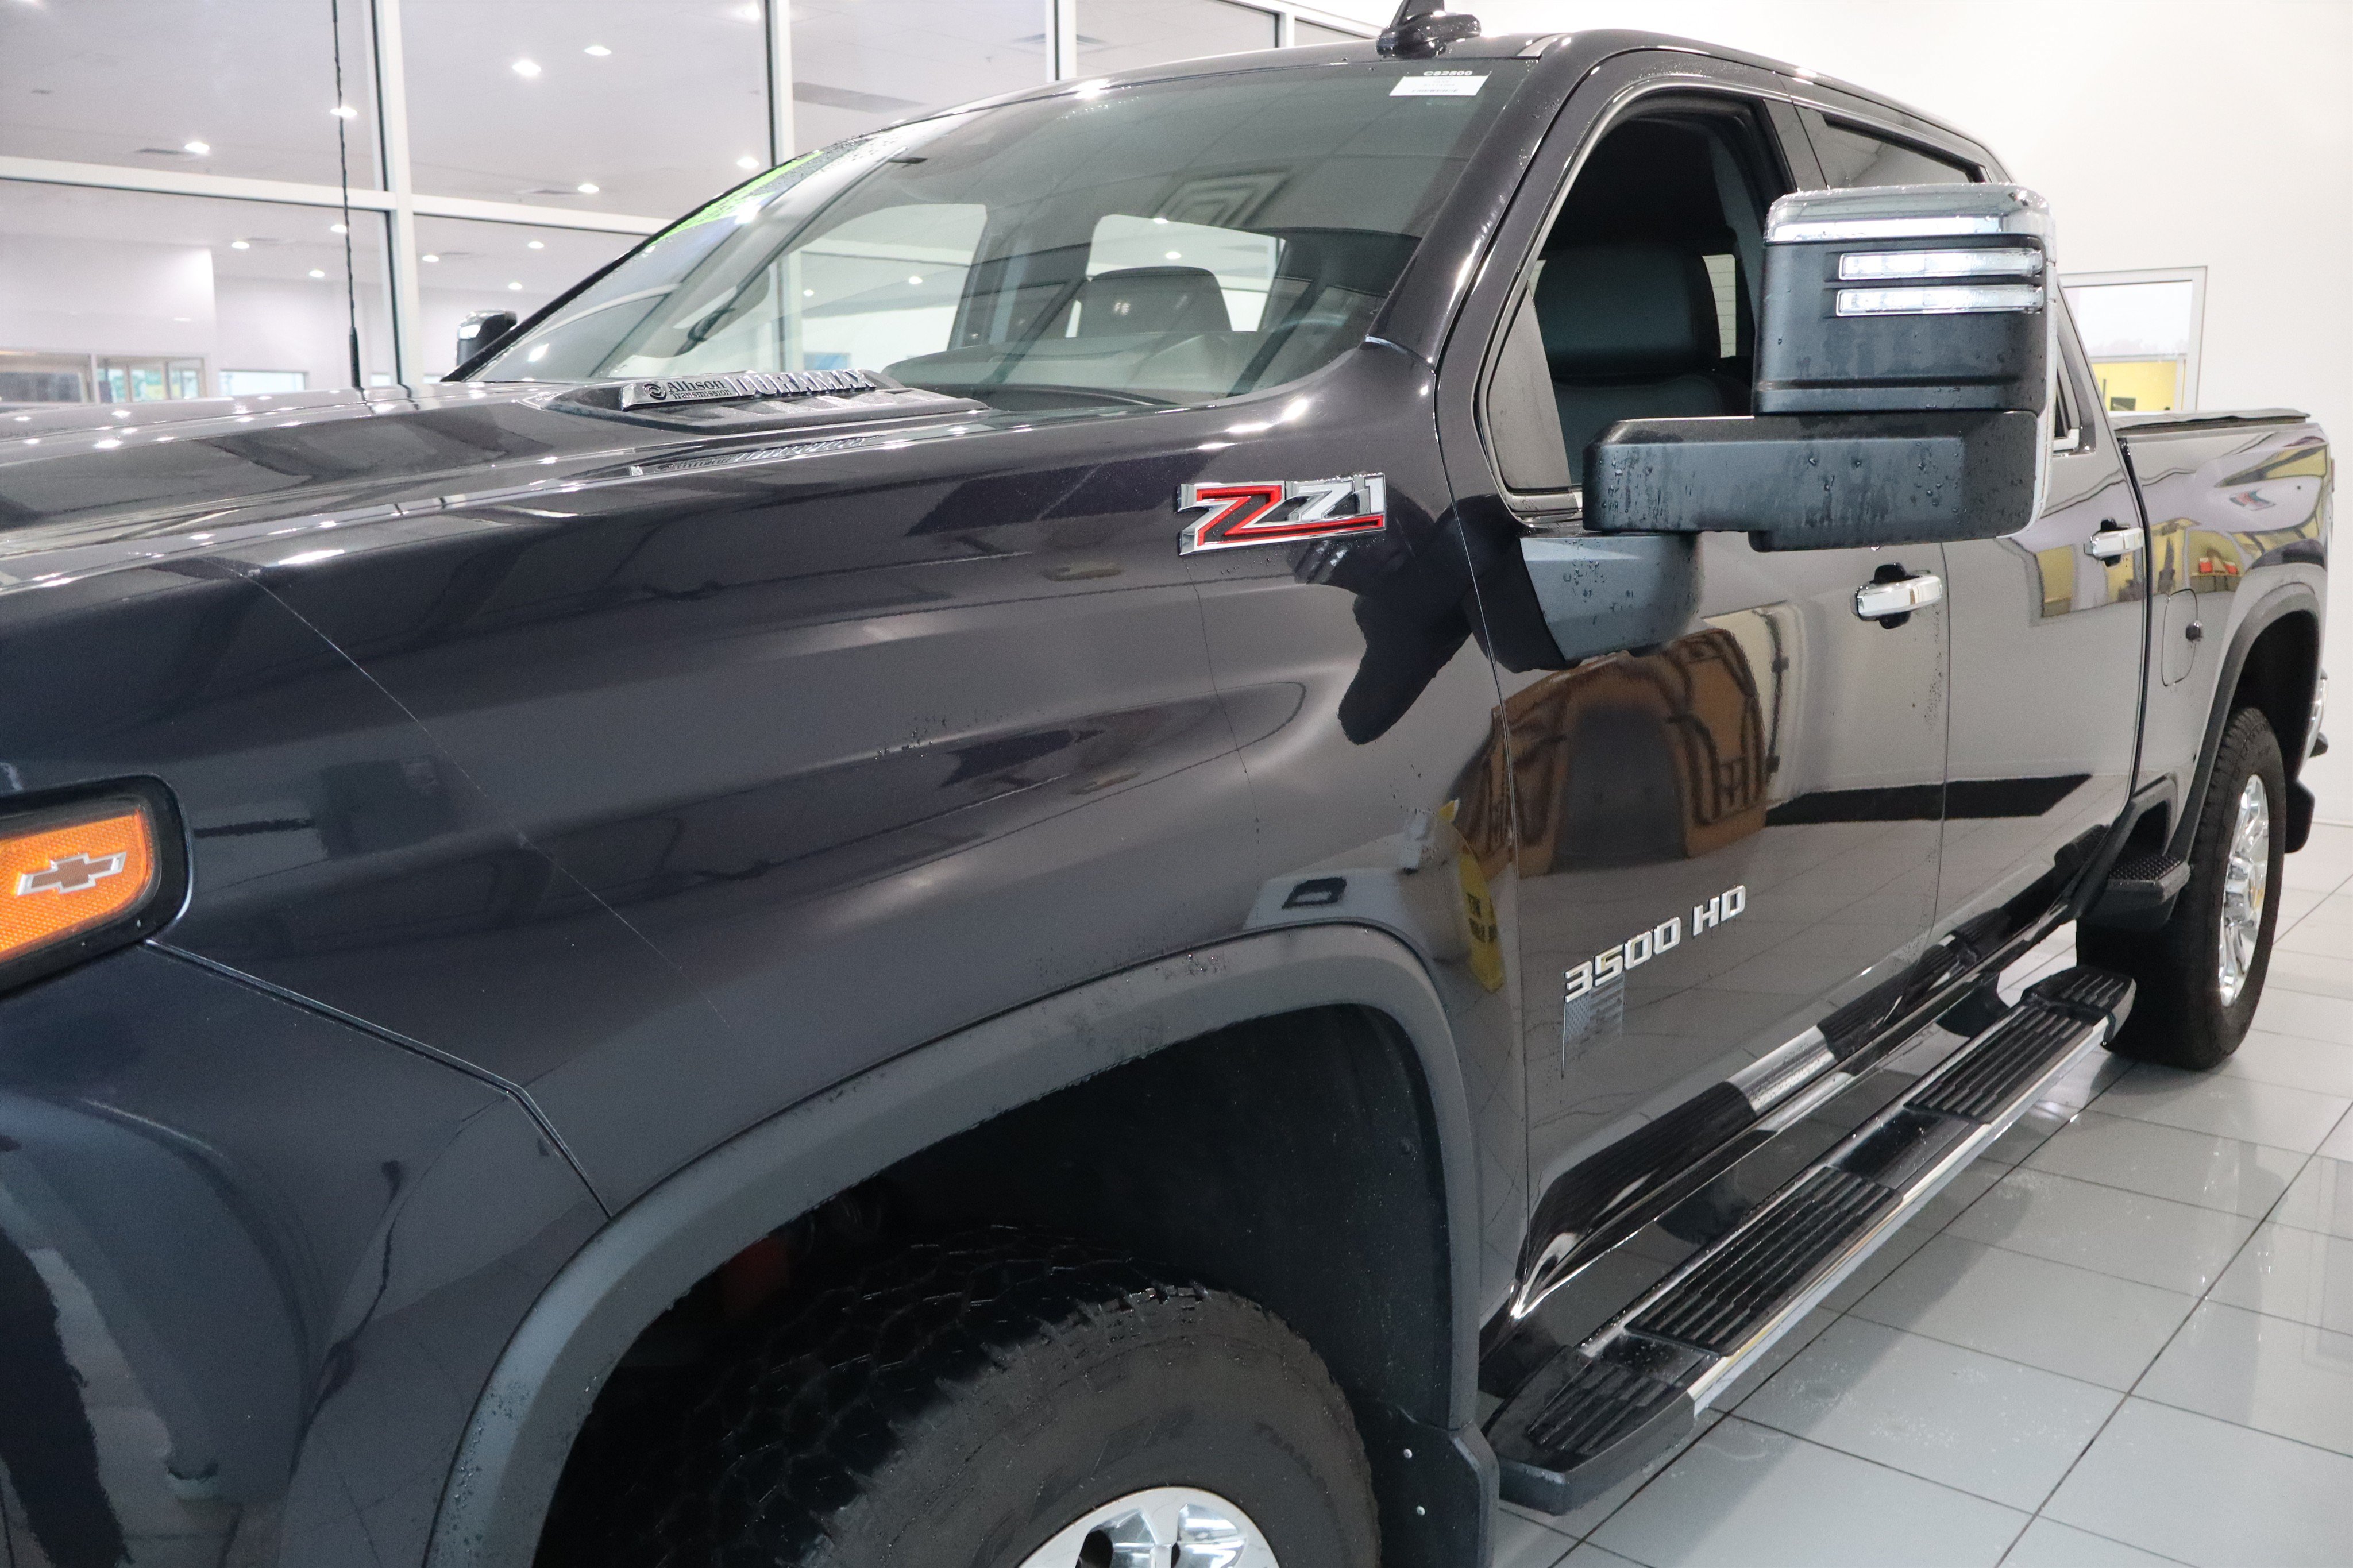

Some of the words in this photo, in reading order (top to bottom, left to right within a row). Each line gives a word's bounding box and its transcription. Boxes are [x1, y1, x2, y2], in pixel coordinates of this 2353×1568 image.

[667, 378, 725, 393] Allison
[670, 388, 732, 400] Transmission
[724, 369, 877, 399] DURAMAX
[1176, 472, 1387, 555] Z71
[1564, 916, 1681, 1003] 3500
[1692, 884, 1746, 936] HD
